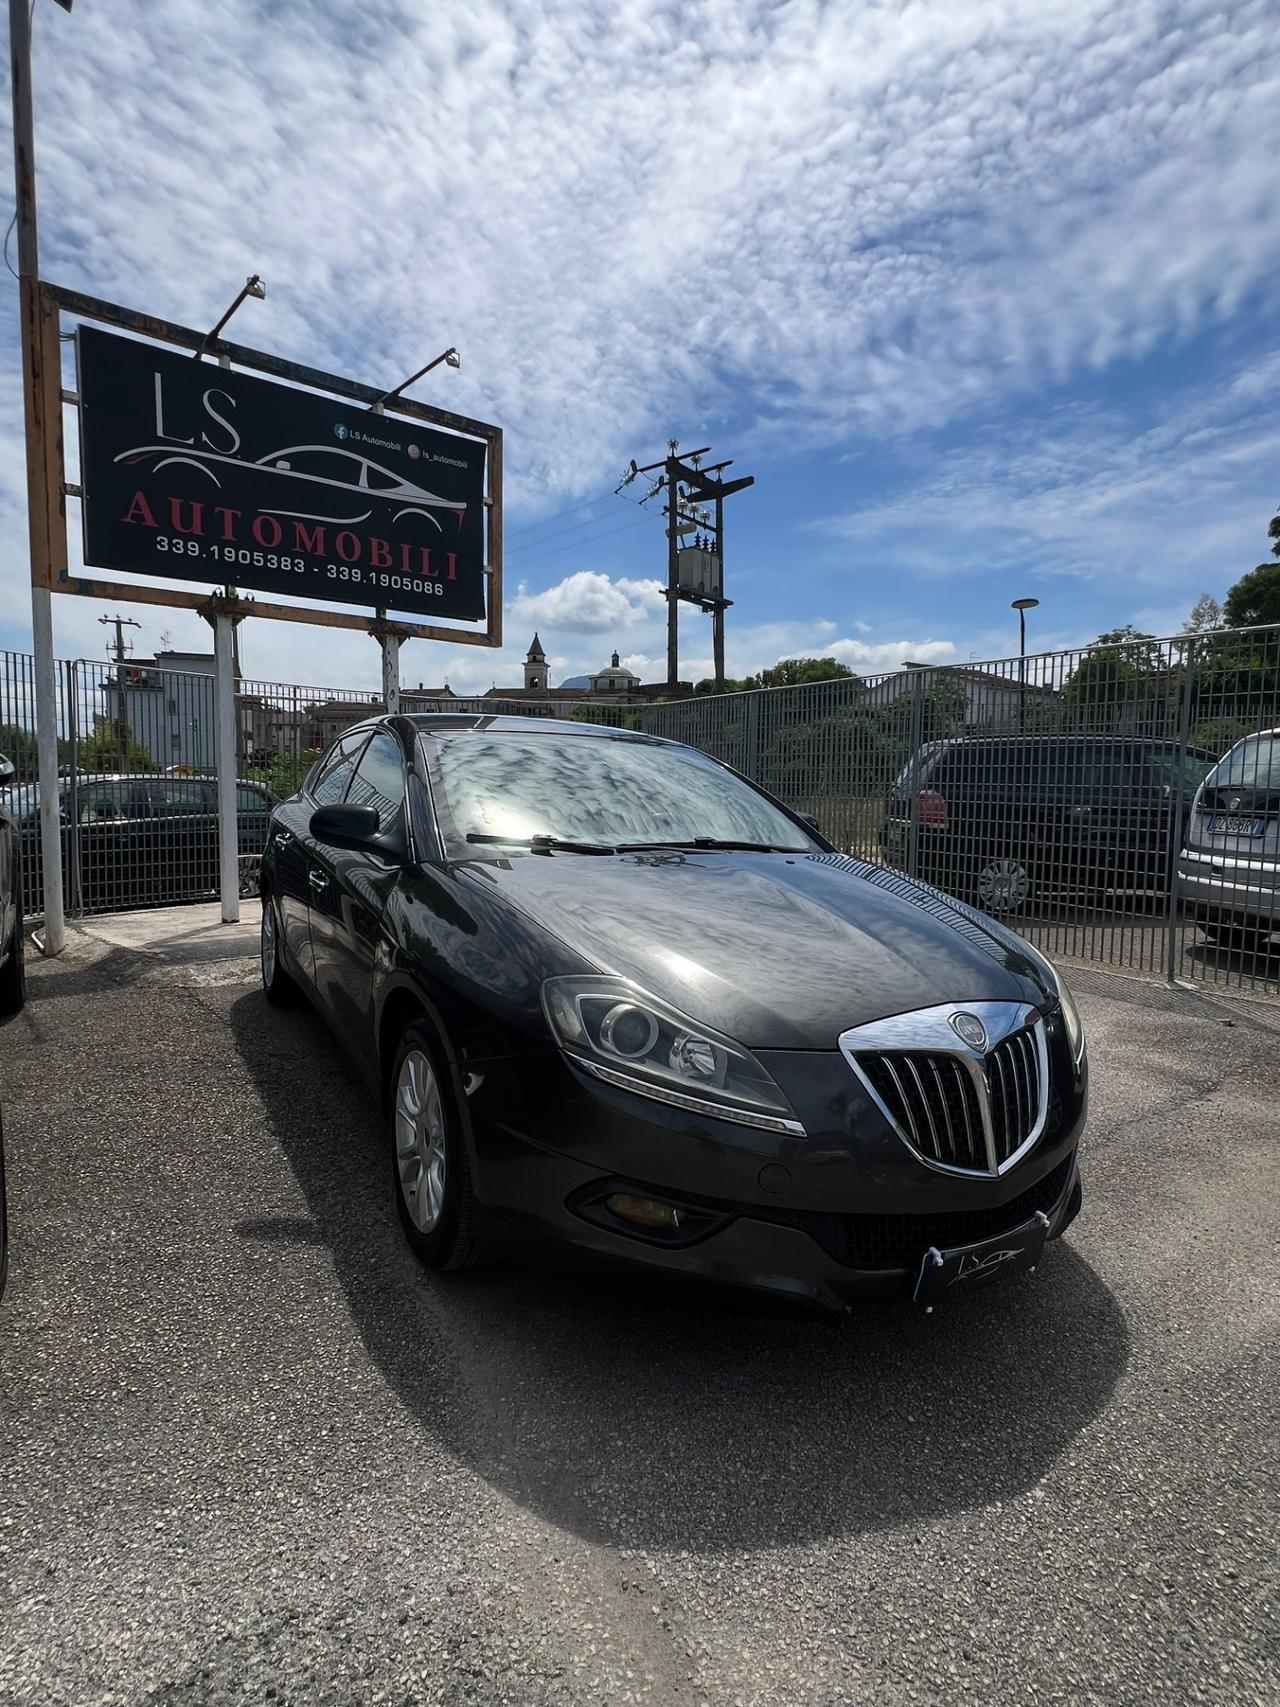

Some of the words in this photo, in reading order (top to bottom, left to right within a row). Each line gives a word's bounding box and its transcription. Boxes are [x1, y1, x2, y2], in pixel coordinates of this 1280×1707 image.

[154, 371, 241, 455] LS
[349, 430, 361, 440] LS
[362, 434, 401, 450] Automobili
[120, 489, 459, 581] AUTOMOBILI
[156, 535, 305, 573] 339.1905383
[327, 564, 444, 596] 339.1905086
